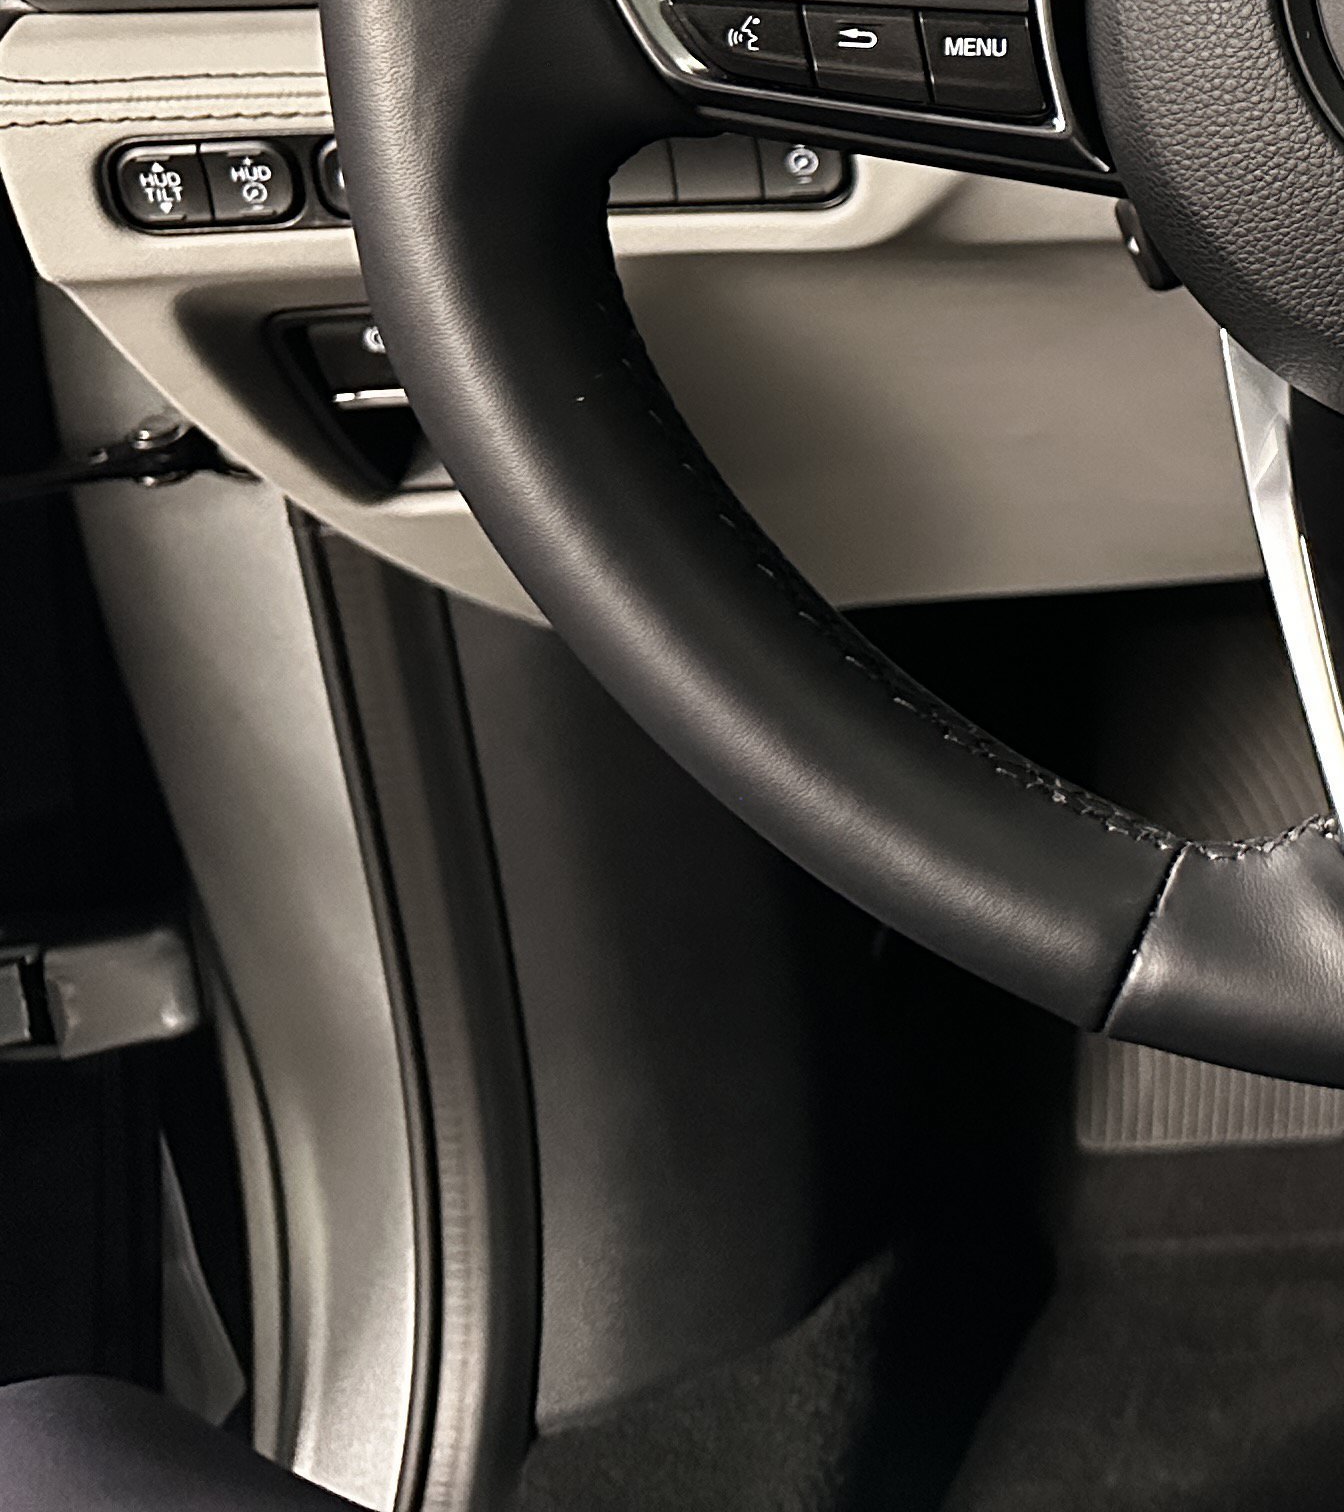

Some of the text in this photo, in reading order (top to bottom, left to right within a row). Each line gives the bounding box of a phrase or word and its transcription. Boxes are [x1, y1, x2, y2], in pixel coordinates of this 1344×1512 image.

[944, 37, 1008, 59] MENU
[139, 172, 182, 188] HUD
[230, 166, 272, 182] HUD
[144, 187, 184, 203] TILT
